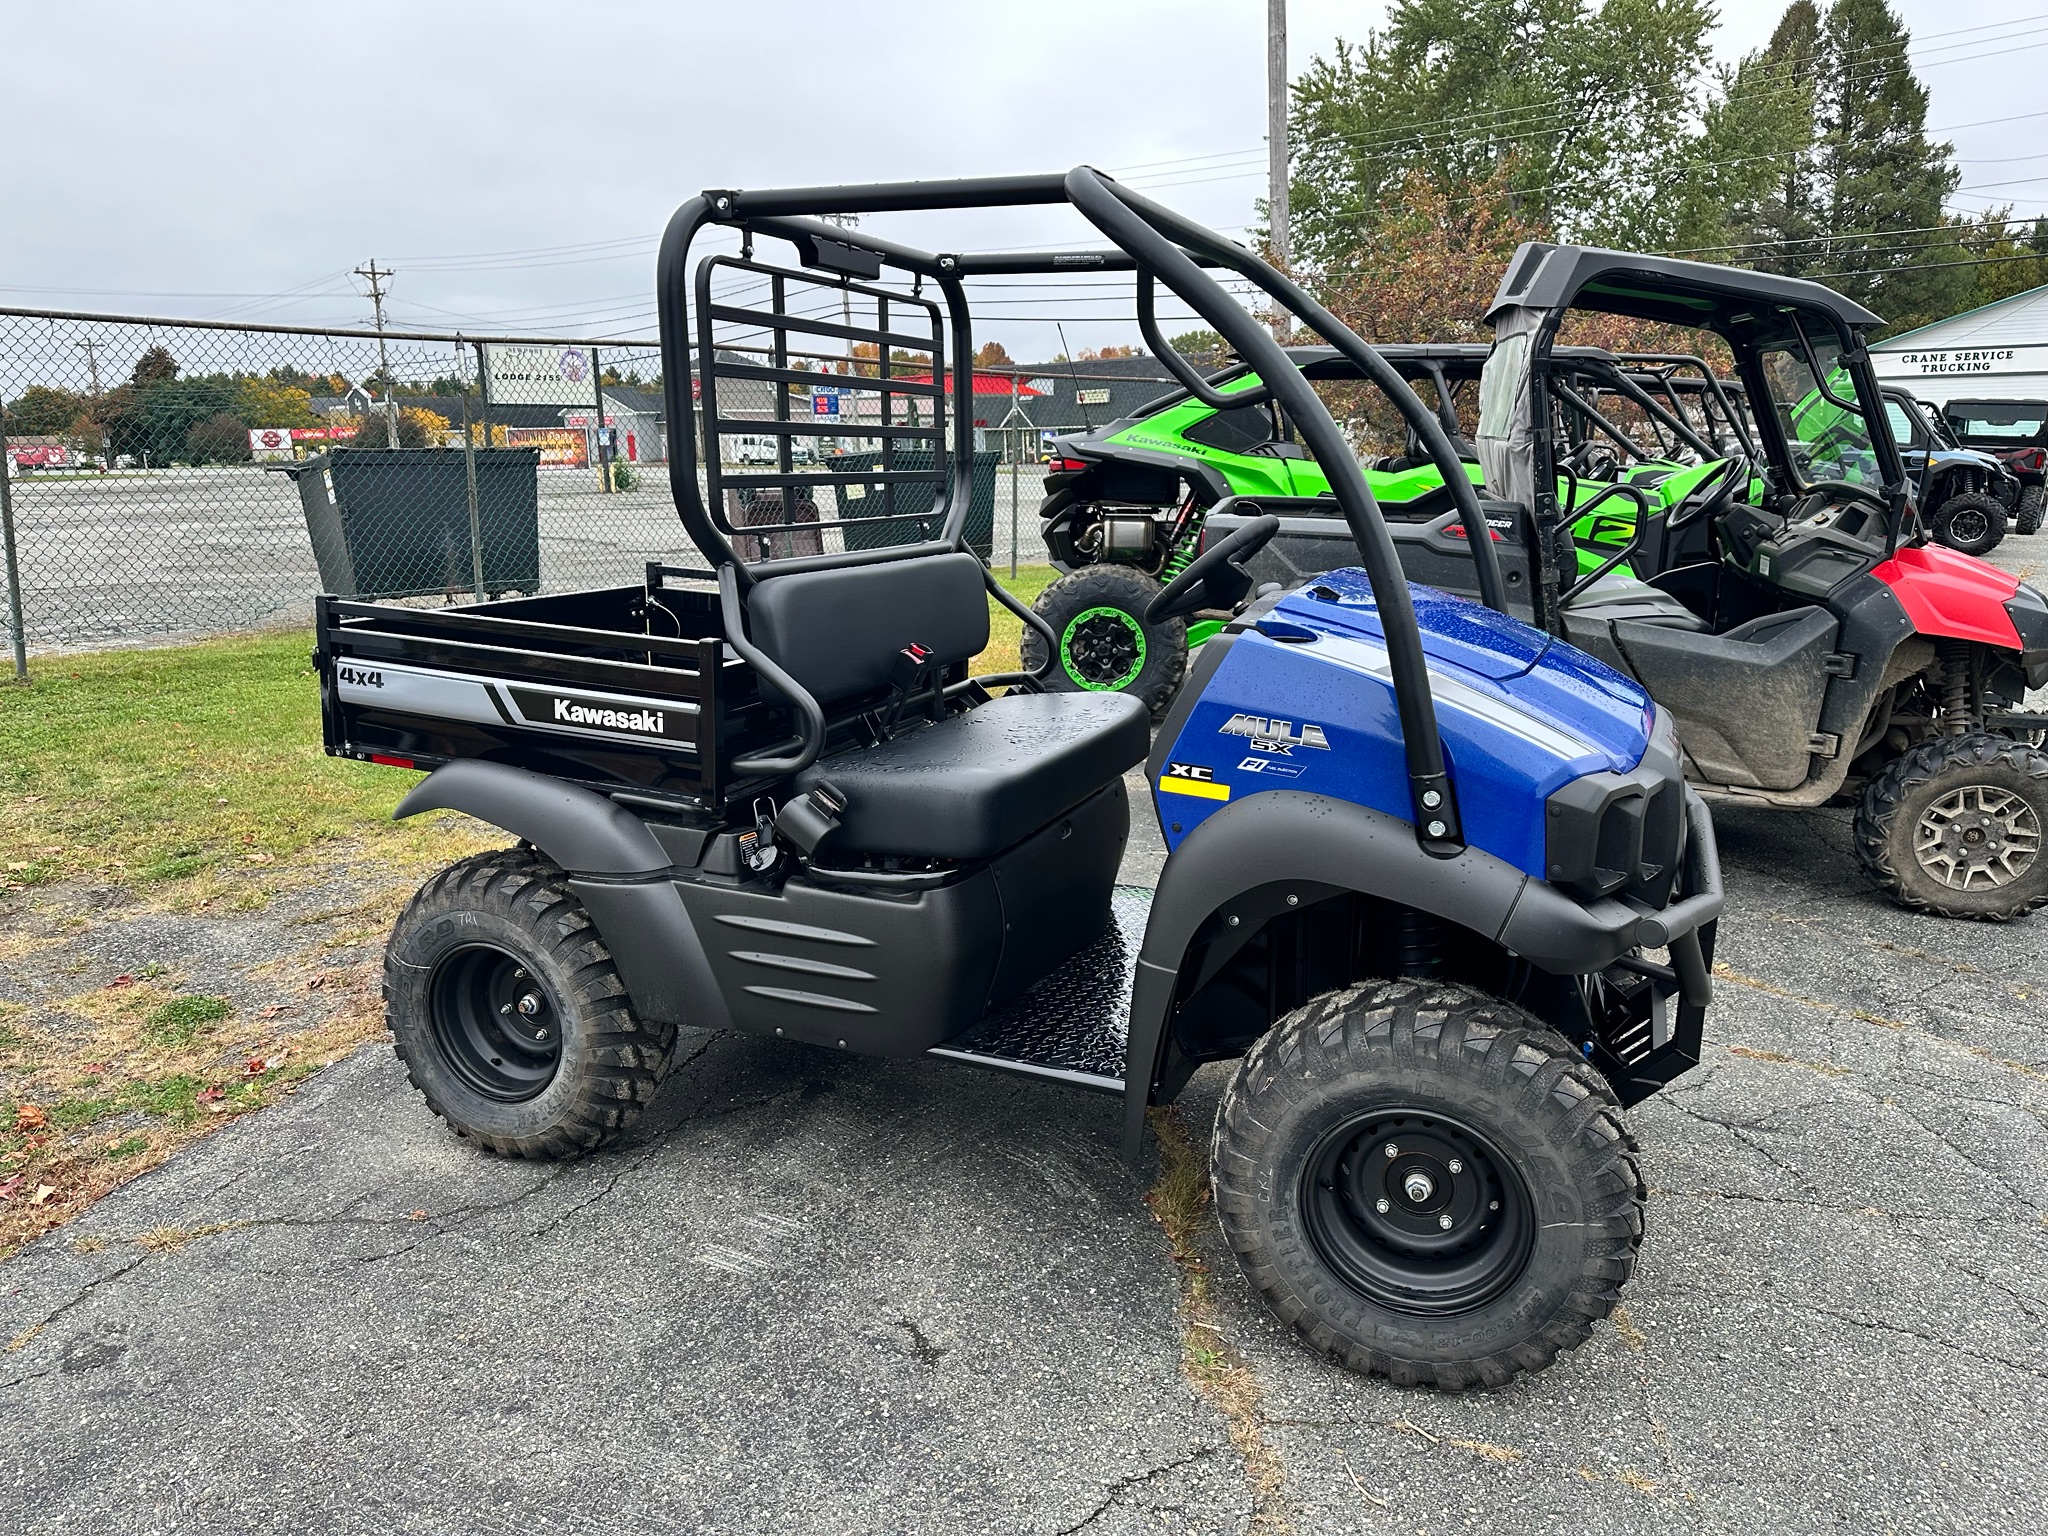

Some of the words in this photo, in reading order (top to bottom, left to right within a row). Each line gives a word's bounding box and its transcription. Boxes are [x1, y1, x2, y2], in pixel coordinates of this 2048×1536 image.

[508, 347, 543, 355] NEWPORT
[1901, 353, 1947, 364] CRANE
[1954, 350, 2014, 362] SERVICE
[1921, 362, 1991, 373] TRUCKING
[495, 373, 531, 381] LODGE
[536, 374, 561, 382] 2155
[1126, 434, 1208, 456] Kawasaki
[339, 667, 385, 689] 4x4
[554, 698, 665, 734] Kawasaki
[1218, 713, 1332, 751] MULE
[1250, 739, 1294, 756] SX
[1170, 763, 1213, 781] XC
[1242, 760, 1264, 770] FI
[1267, 1205, 1366, 1333] FRONTIER
